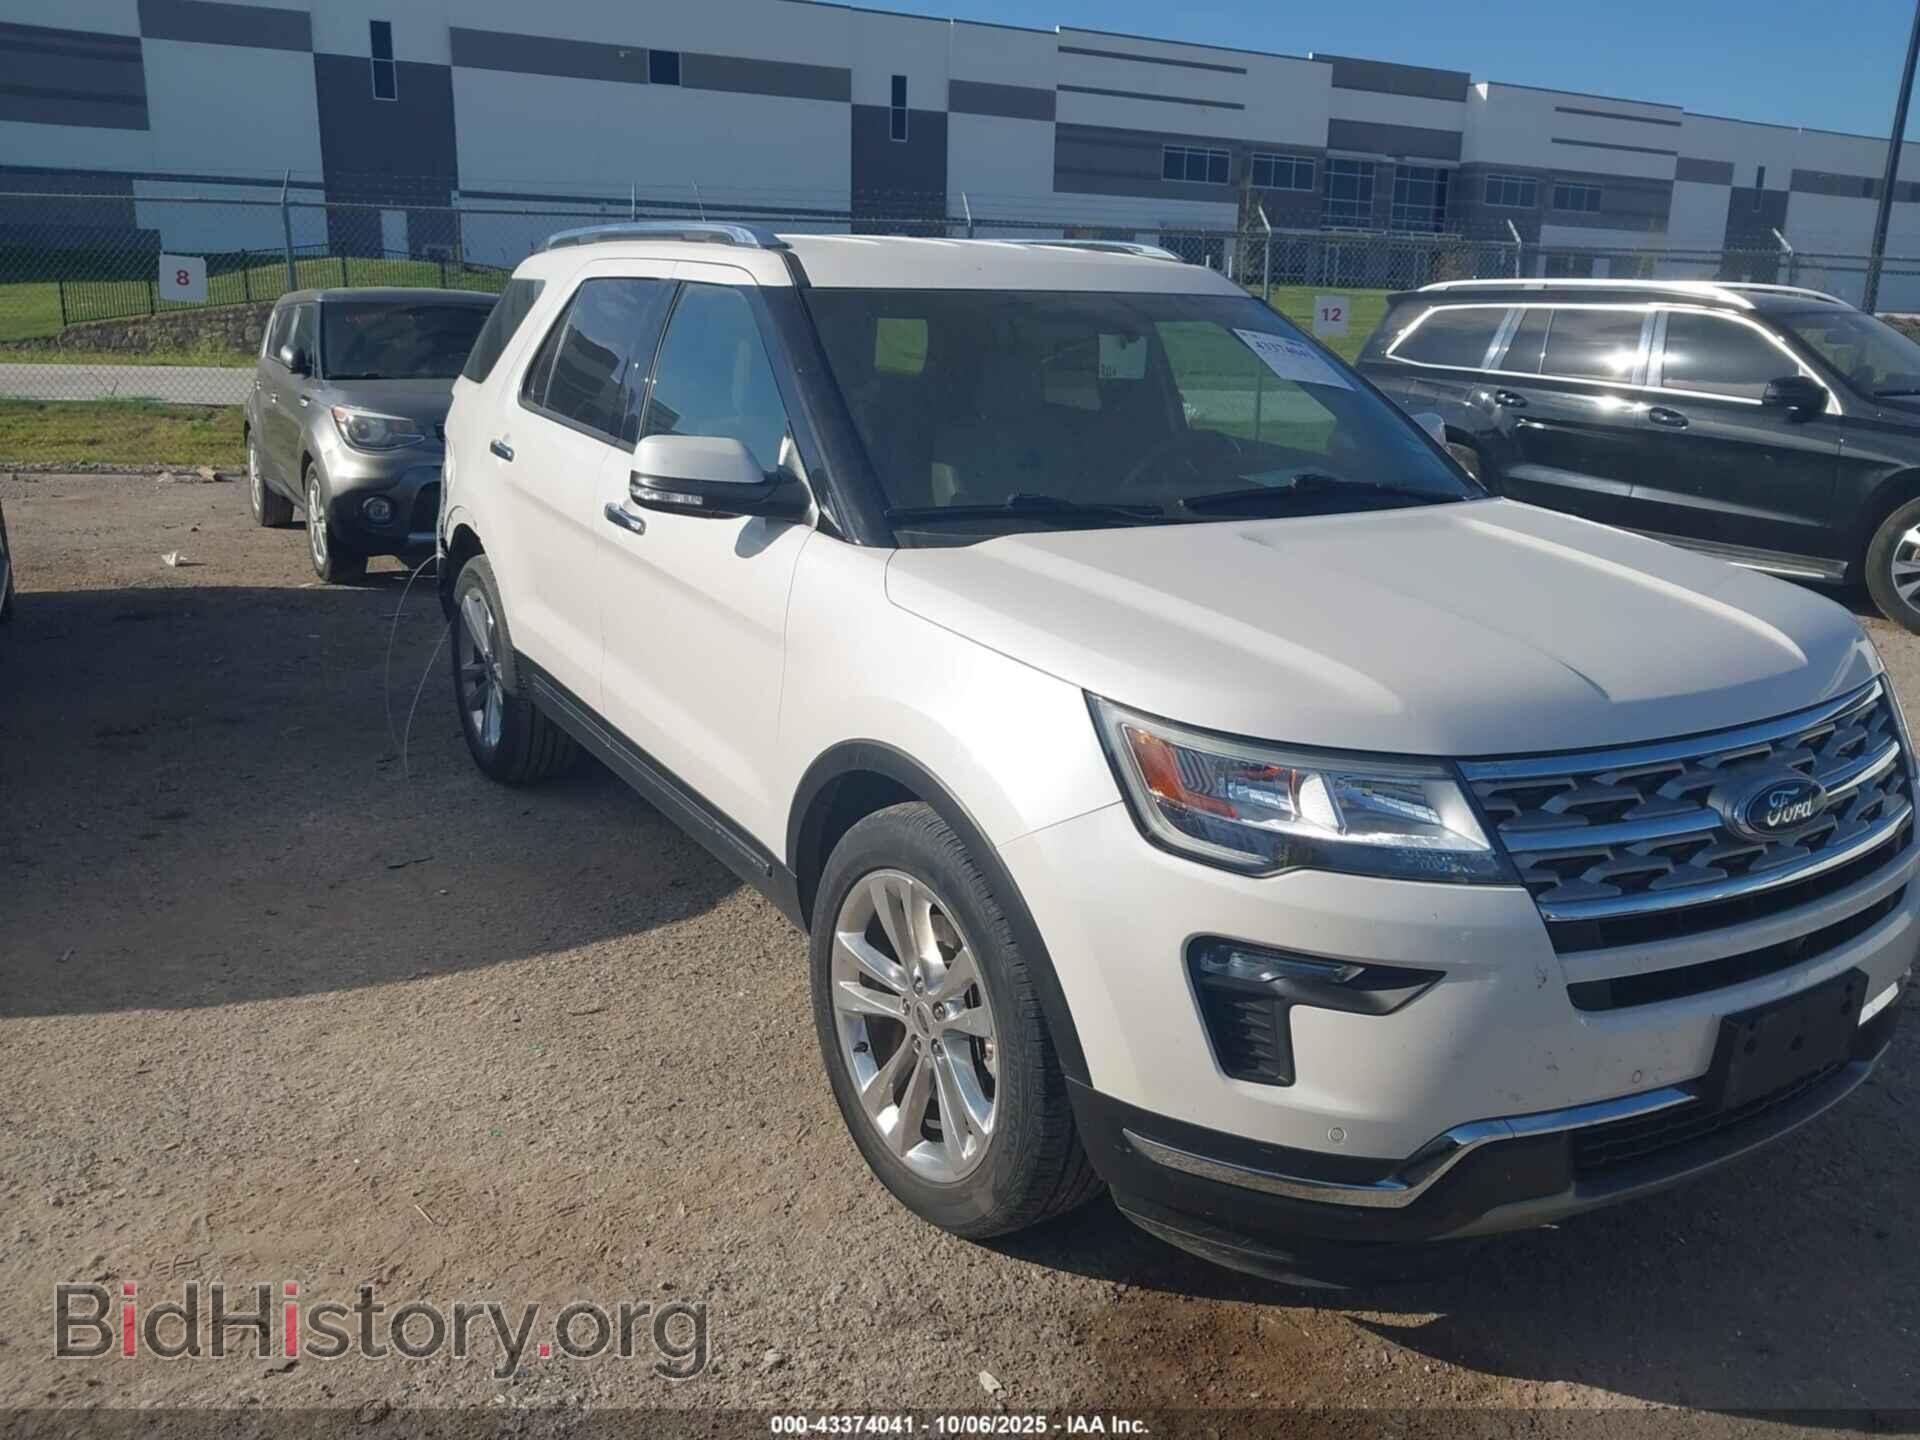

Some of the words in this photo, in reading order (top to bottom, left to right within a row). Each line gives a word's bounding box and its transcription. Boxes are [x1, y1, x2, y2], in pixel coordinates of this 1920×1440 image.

[176, 270, 190, 286] 8
[1322, 308, 1342, 322] 12
[1766, 787, 1812, 827] Ford
